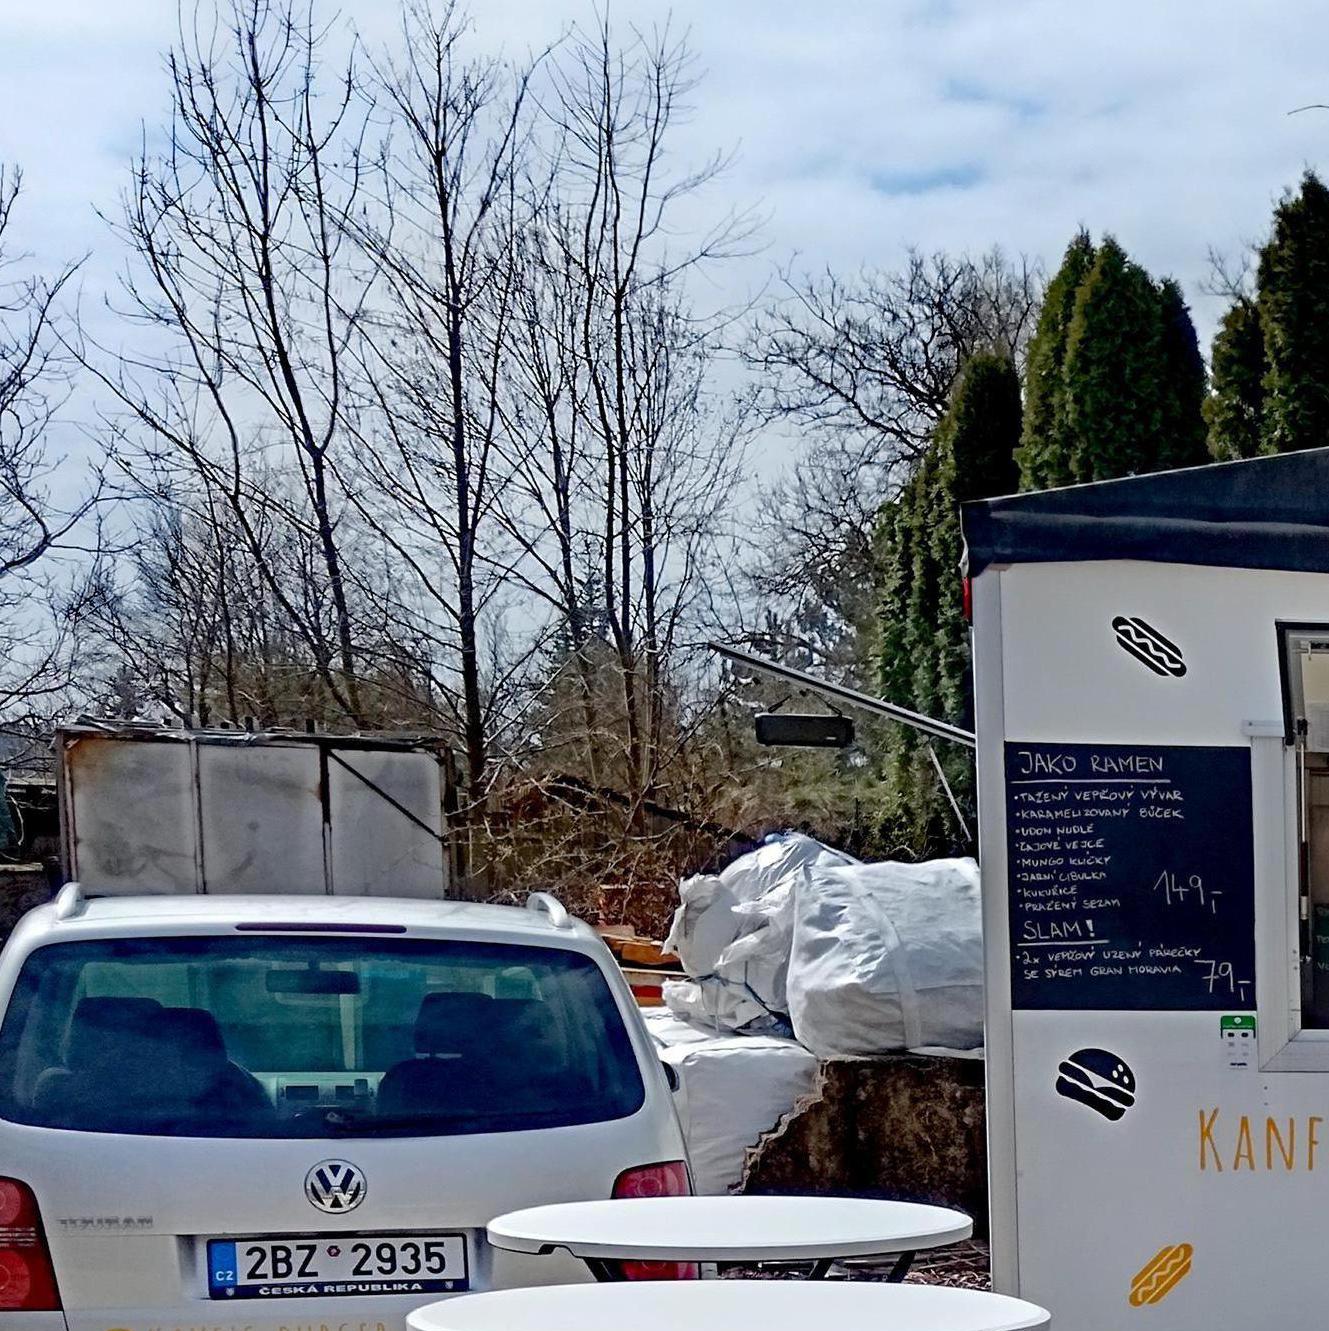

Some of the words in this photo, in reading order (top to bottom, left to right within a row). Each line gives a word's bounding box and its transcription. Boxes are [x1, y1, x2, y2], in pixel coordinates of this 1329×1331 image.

[1018, 752, 1076, 774] JAKO
[1091, 756, 1163, 772] RAMEN
[246, 1243, 319, 1280] 2BZ
[351, 1241, 446, 1276] 2935
[258, 1283, 320, 1296] ČESKÁ
[323, 1281, 423, 1294] REPUBLIKA
